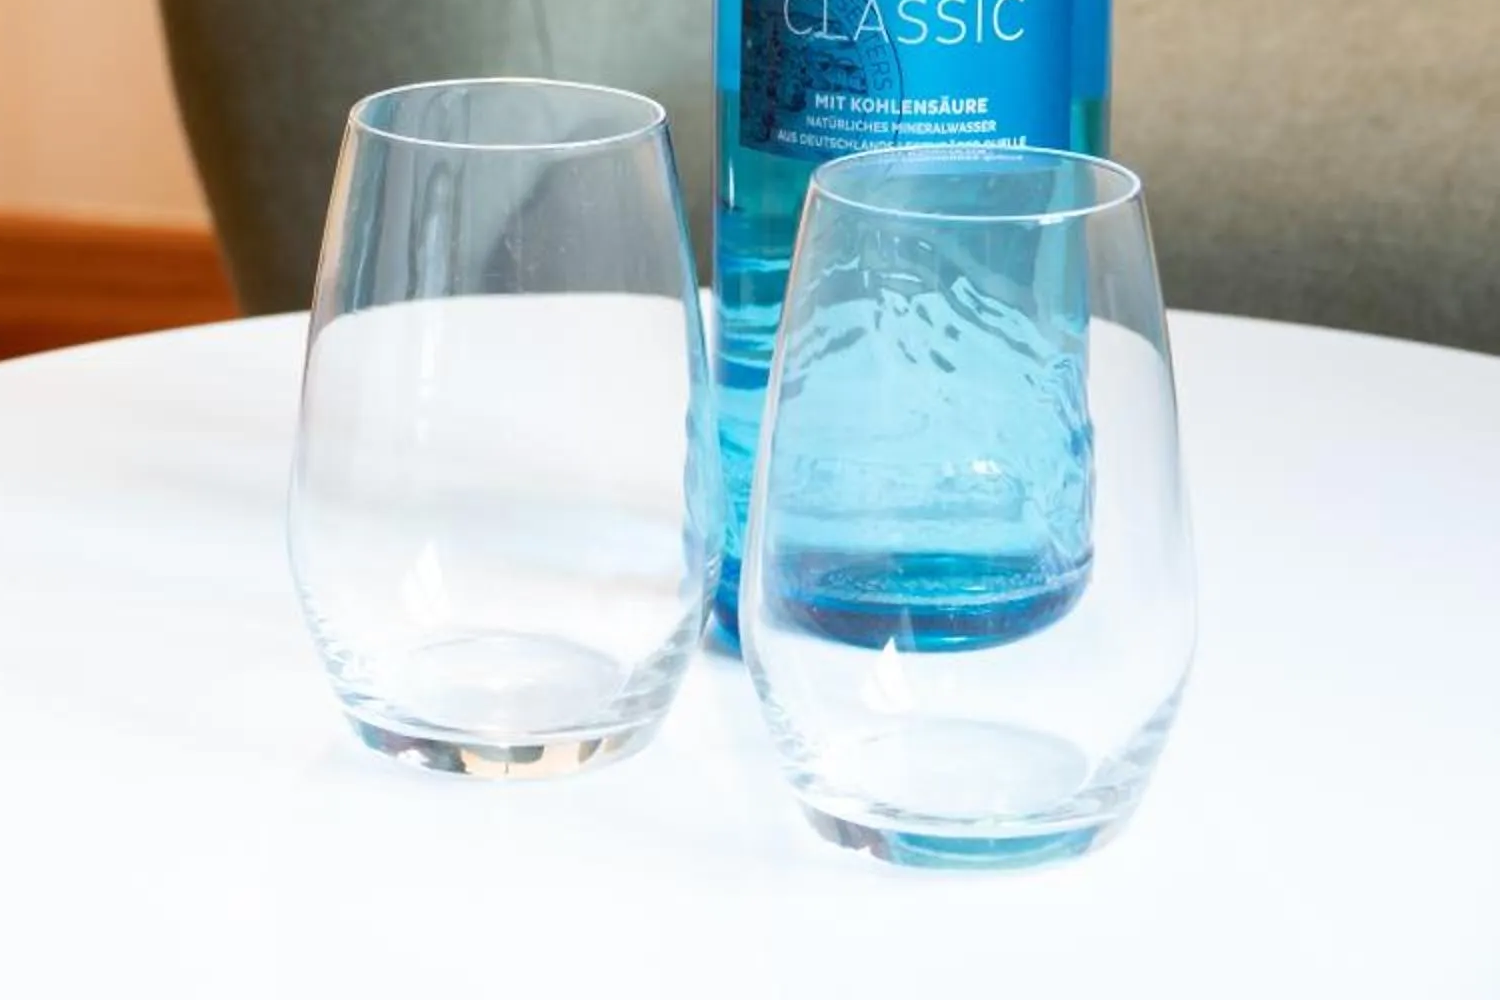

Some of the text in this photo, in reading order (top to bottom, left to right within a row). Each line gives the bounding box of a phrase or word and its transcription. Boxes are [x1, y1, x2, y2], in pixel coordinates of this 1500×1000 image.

[814, 93, 989, 115] MIT KOHLENSÄURE
[806, 115, 997, 135] NATÜRLICHES MINERALWASSER
